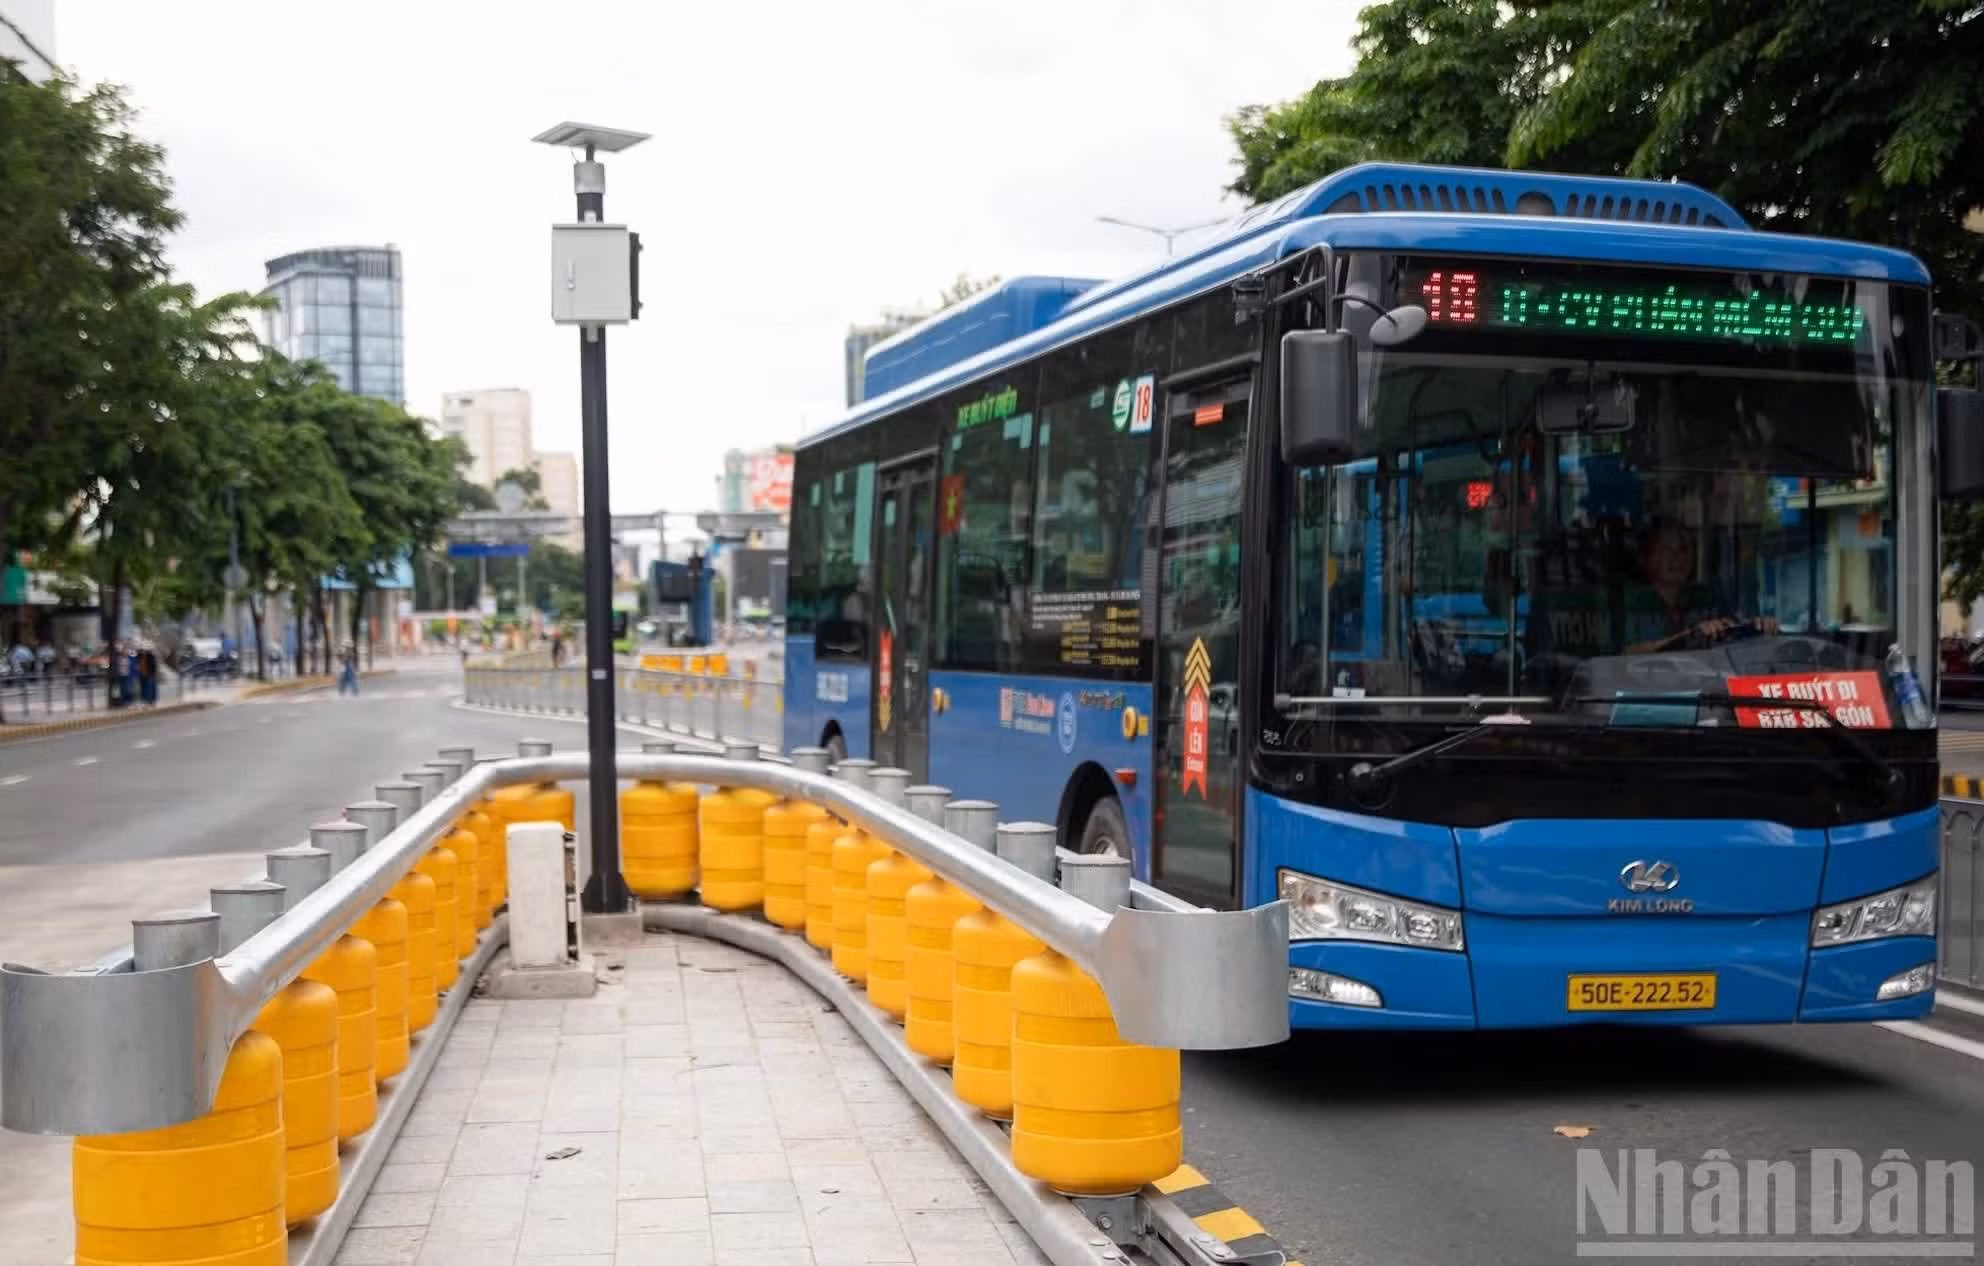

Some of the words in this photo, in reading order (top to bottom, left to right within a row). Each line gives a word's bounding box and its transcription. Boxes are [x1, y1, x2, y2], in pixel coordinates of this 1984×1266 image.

[1136, 385, 1150, 425] 18
[1608, 899, 1642, 913] KIM
[1646, 899, 1693, 913] LONG
[1581, 982, 1704, 1004] 50E-222.52
